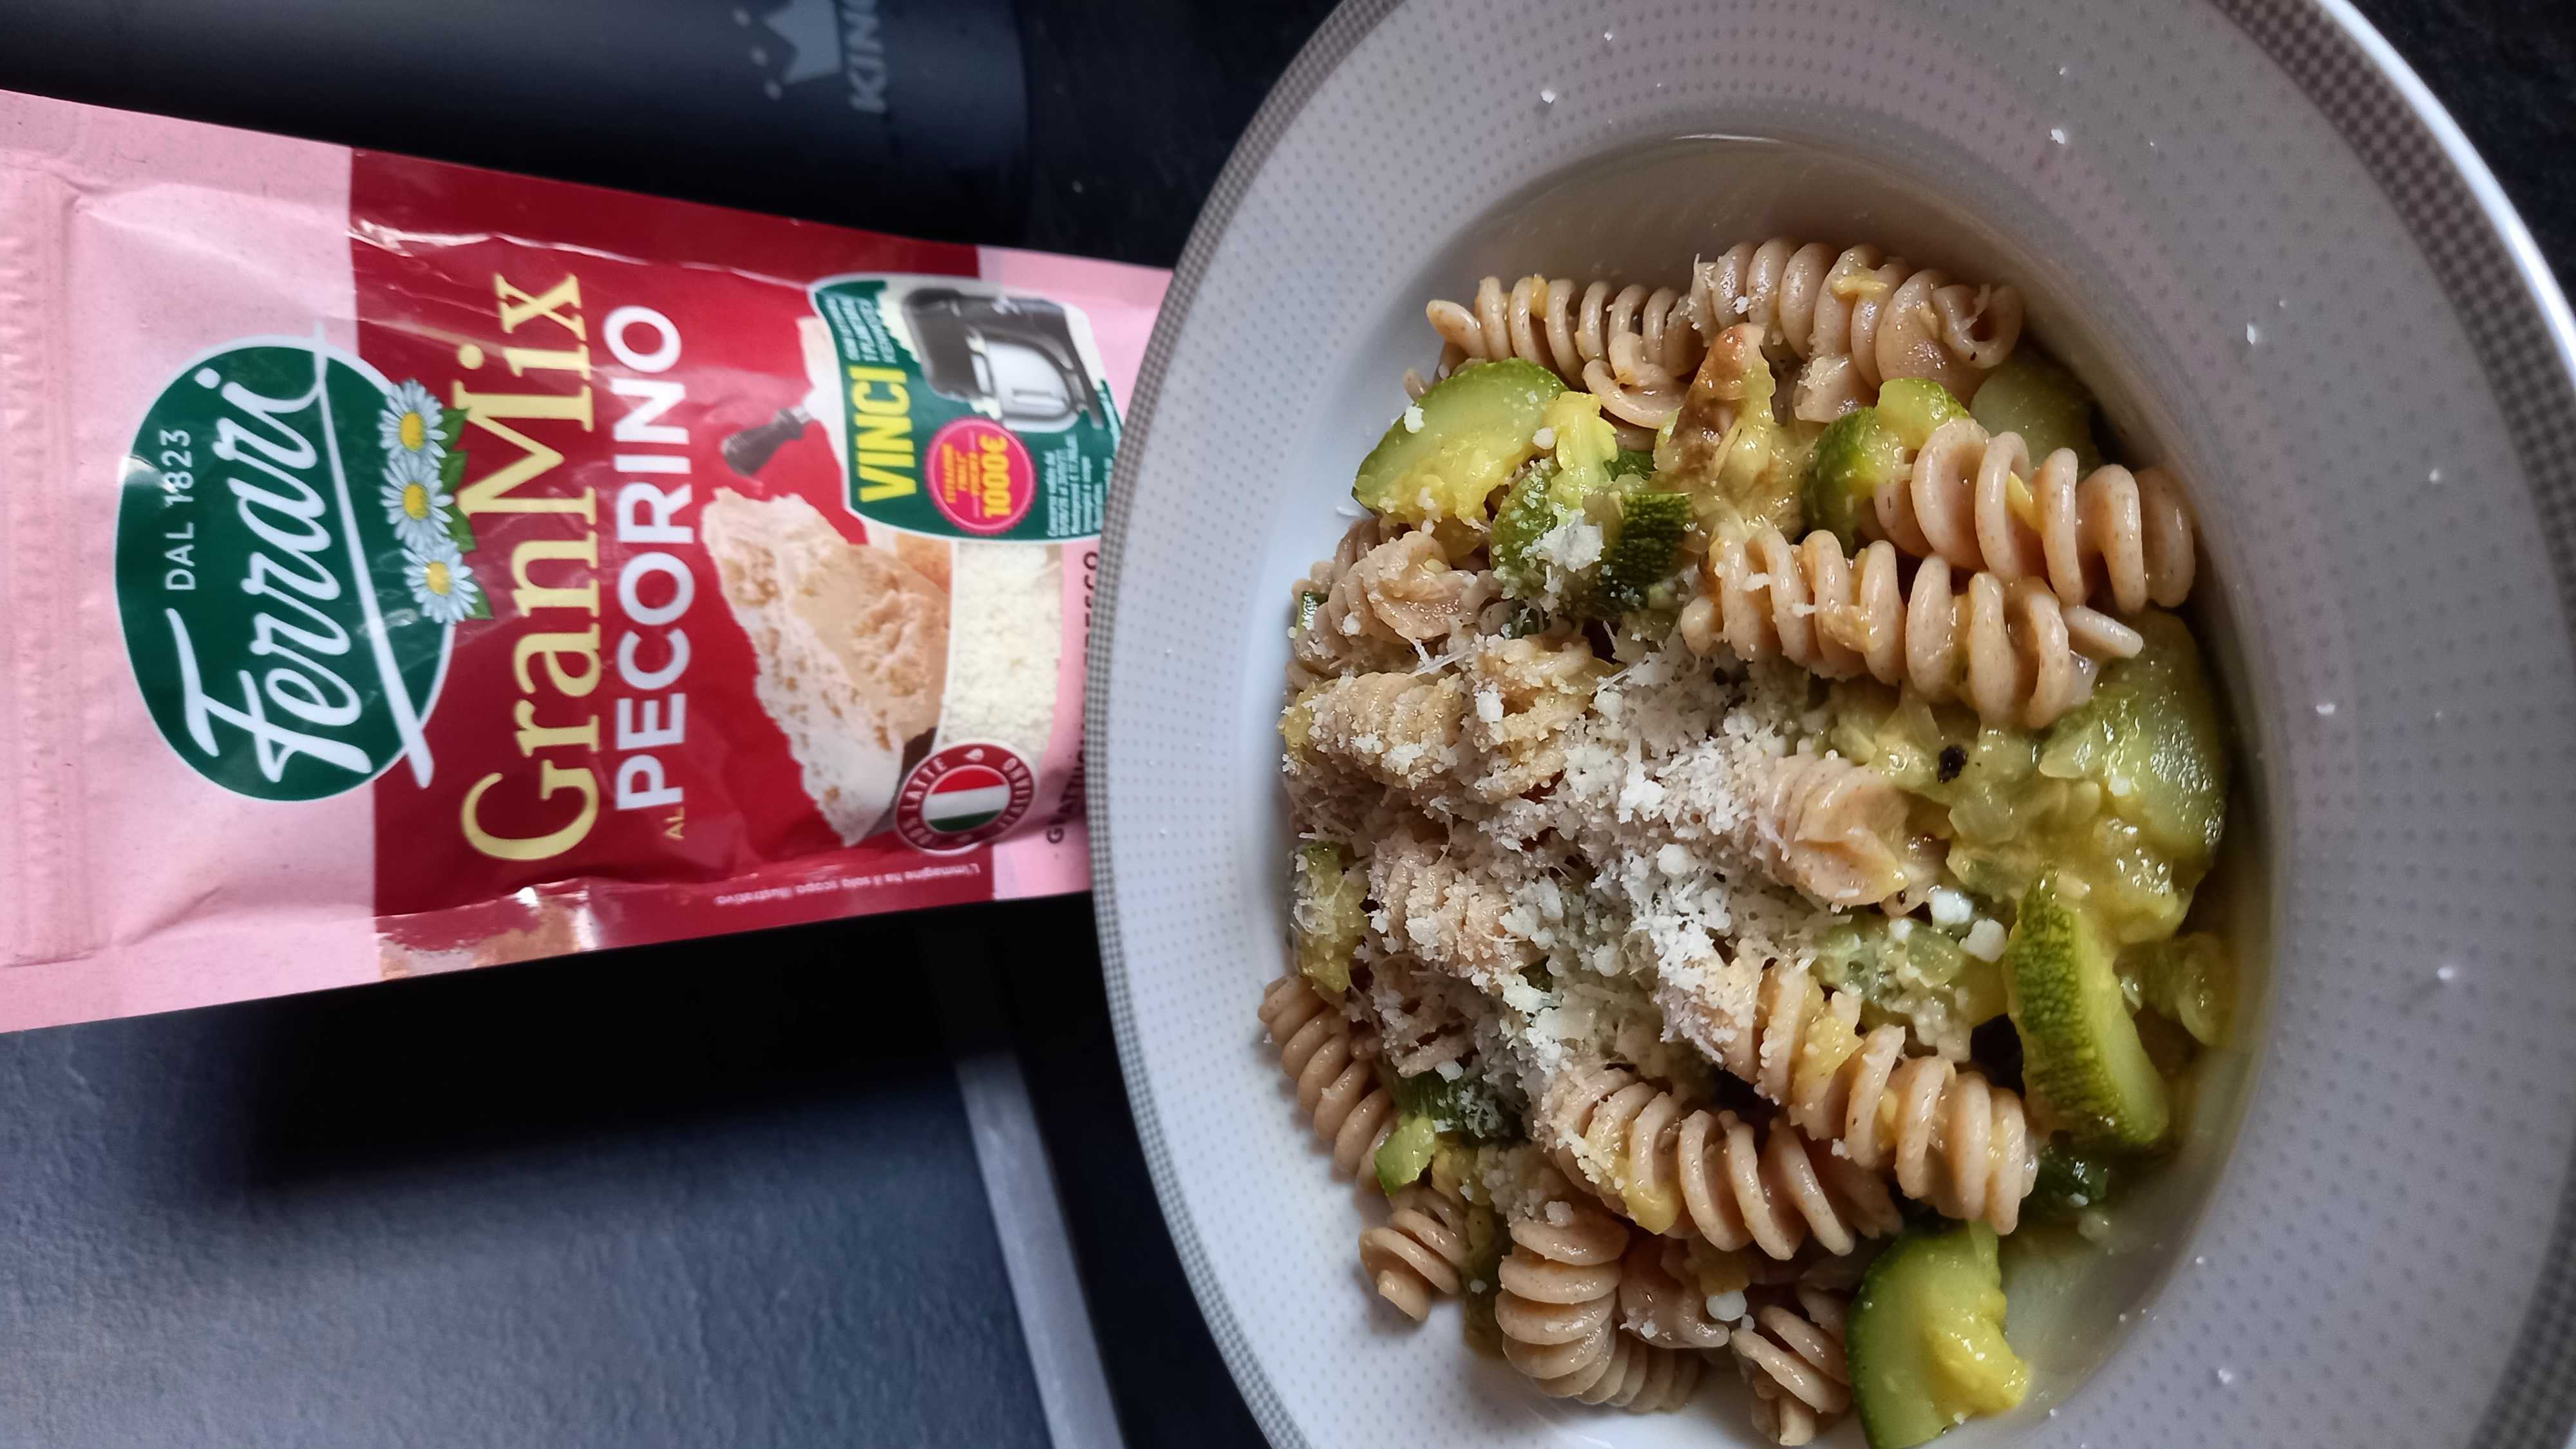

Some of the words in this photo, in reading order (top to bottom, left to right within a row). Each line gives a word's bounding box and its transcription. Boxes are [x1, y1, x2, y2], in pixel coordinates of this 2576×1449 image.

[841, 0, 887, 113] KIN
[158, 428, 194, 506] 1823
[848, 364, 918, 502] VINCI
[979, 433, 1012, 518] 1000€
[162, 361, 374, 782] Ferrari
[165, 521, 196, 591] DAL
[452, 270, 601, 860] GranMix
[602, 304, 696, 811] PECORINO
[663, 806, 686, 840] AL
[902, 755, 947, 811] LATTE
[998, 757, 1031, 830] ITALIANO
